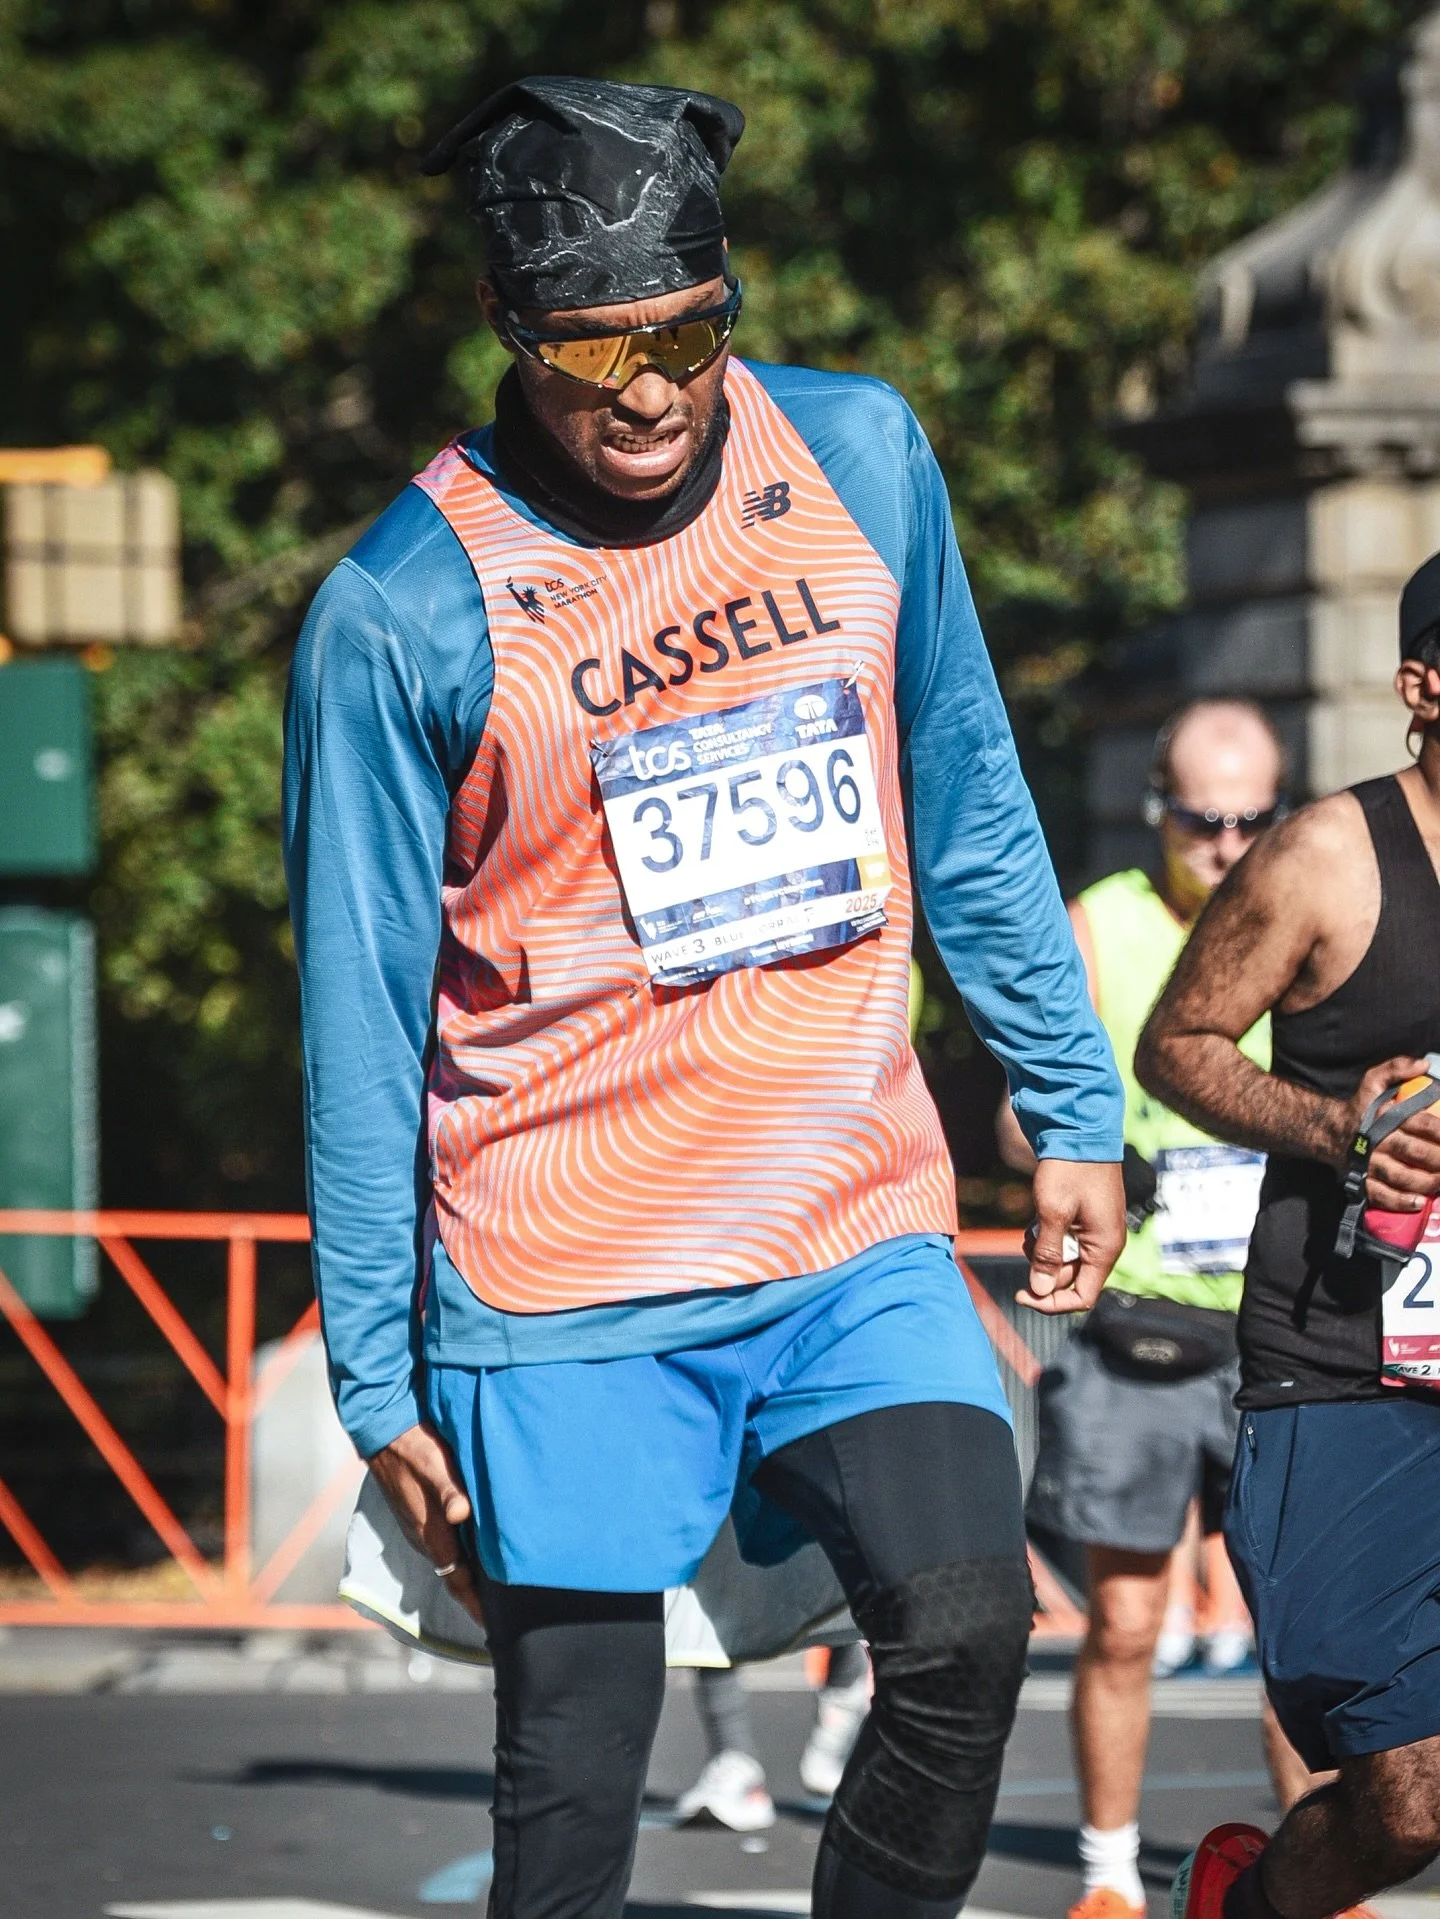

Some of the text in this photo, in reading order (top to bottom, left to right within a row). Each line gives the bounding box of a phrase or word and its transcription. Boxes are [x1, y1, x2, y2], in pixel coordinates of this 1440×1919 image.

[550, 574, 608, 602] NEW YORK CITY
[554, 588, 598, 609] MARATHON
[570, 577, 842, 717] CASSELL
[688, 723, 725, 741] TATA
[692, 722, 773, 753] CONSULTANCY
[794, 718, 839, 740] TATA
[628, 740, 692, 782] tcs
[696, 742, 750, 765] SERVICES
[632, 748, 862, 874] 37596
[845, 893, 878, 914] 2025
[651, 945, 689, 964] WAVE
[692, 938, 706, 954] 3
[1398, 1365, 1418, 1375] AVE
[1420, 1364, 1431, 1376] 2
